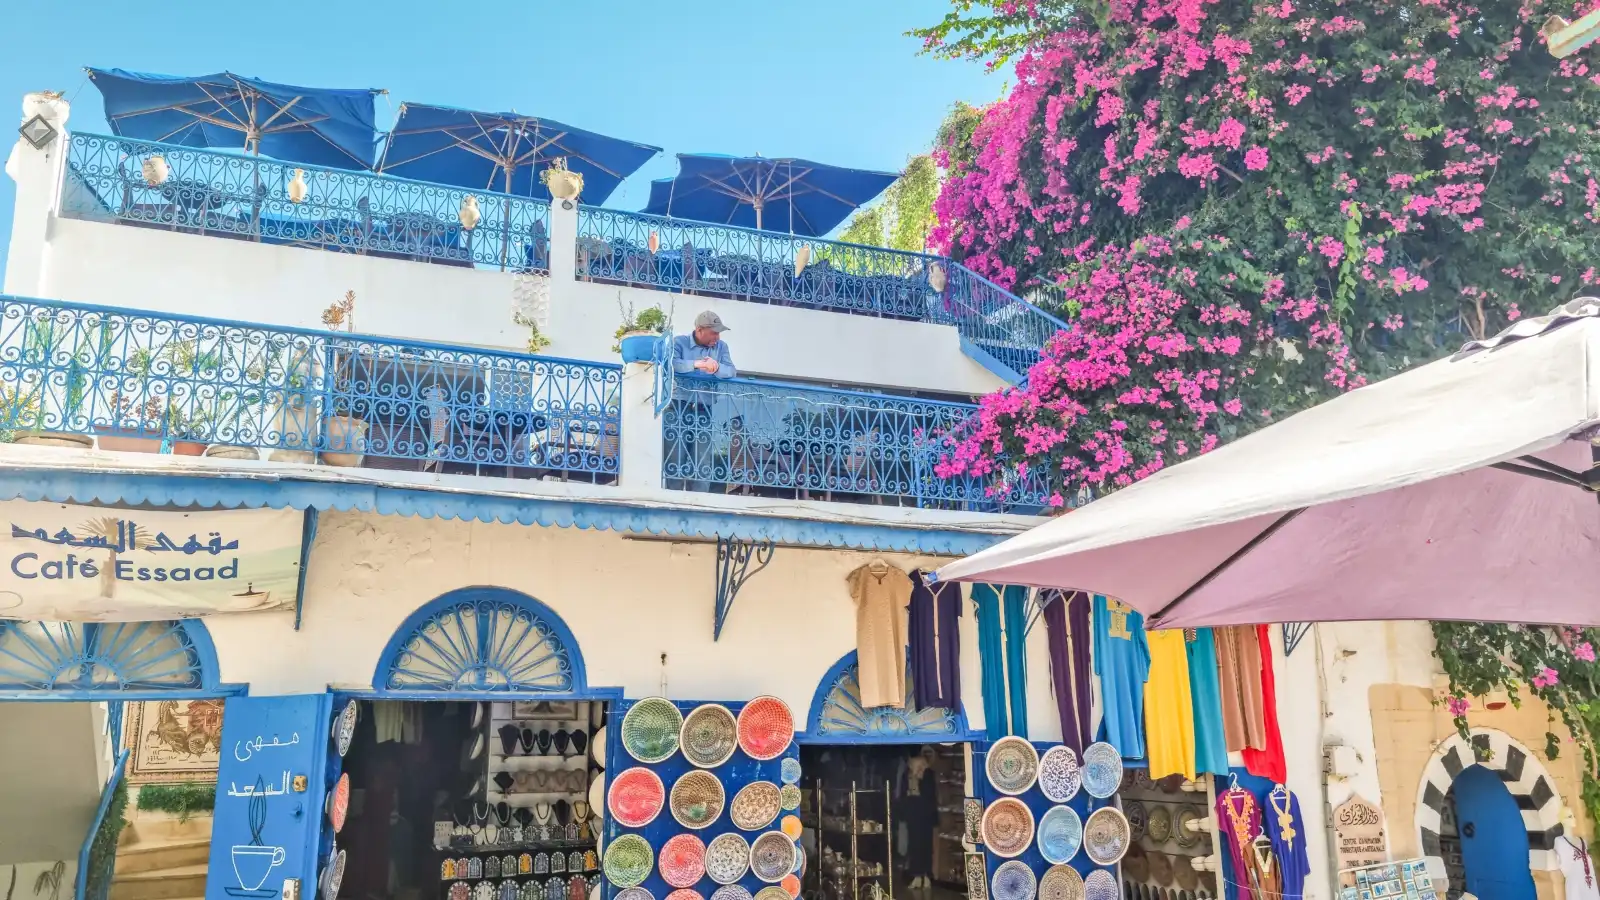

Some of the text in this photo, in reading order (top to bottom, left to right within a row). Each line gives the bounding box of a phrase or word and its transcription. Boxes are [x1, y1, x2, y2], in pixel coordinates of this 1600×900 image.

[11, 519, 137, 554] السعد
[11, 552, 239, 581] Café Essaad
[227, 770, 291, 797] السعد
